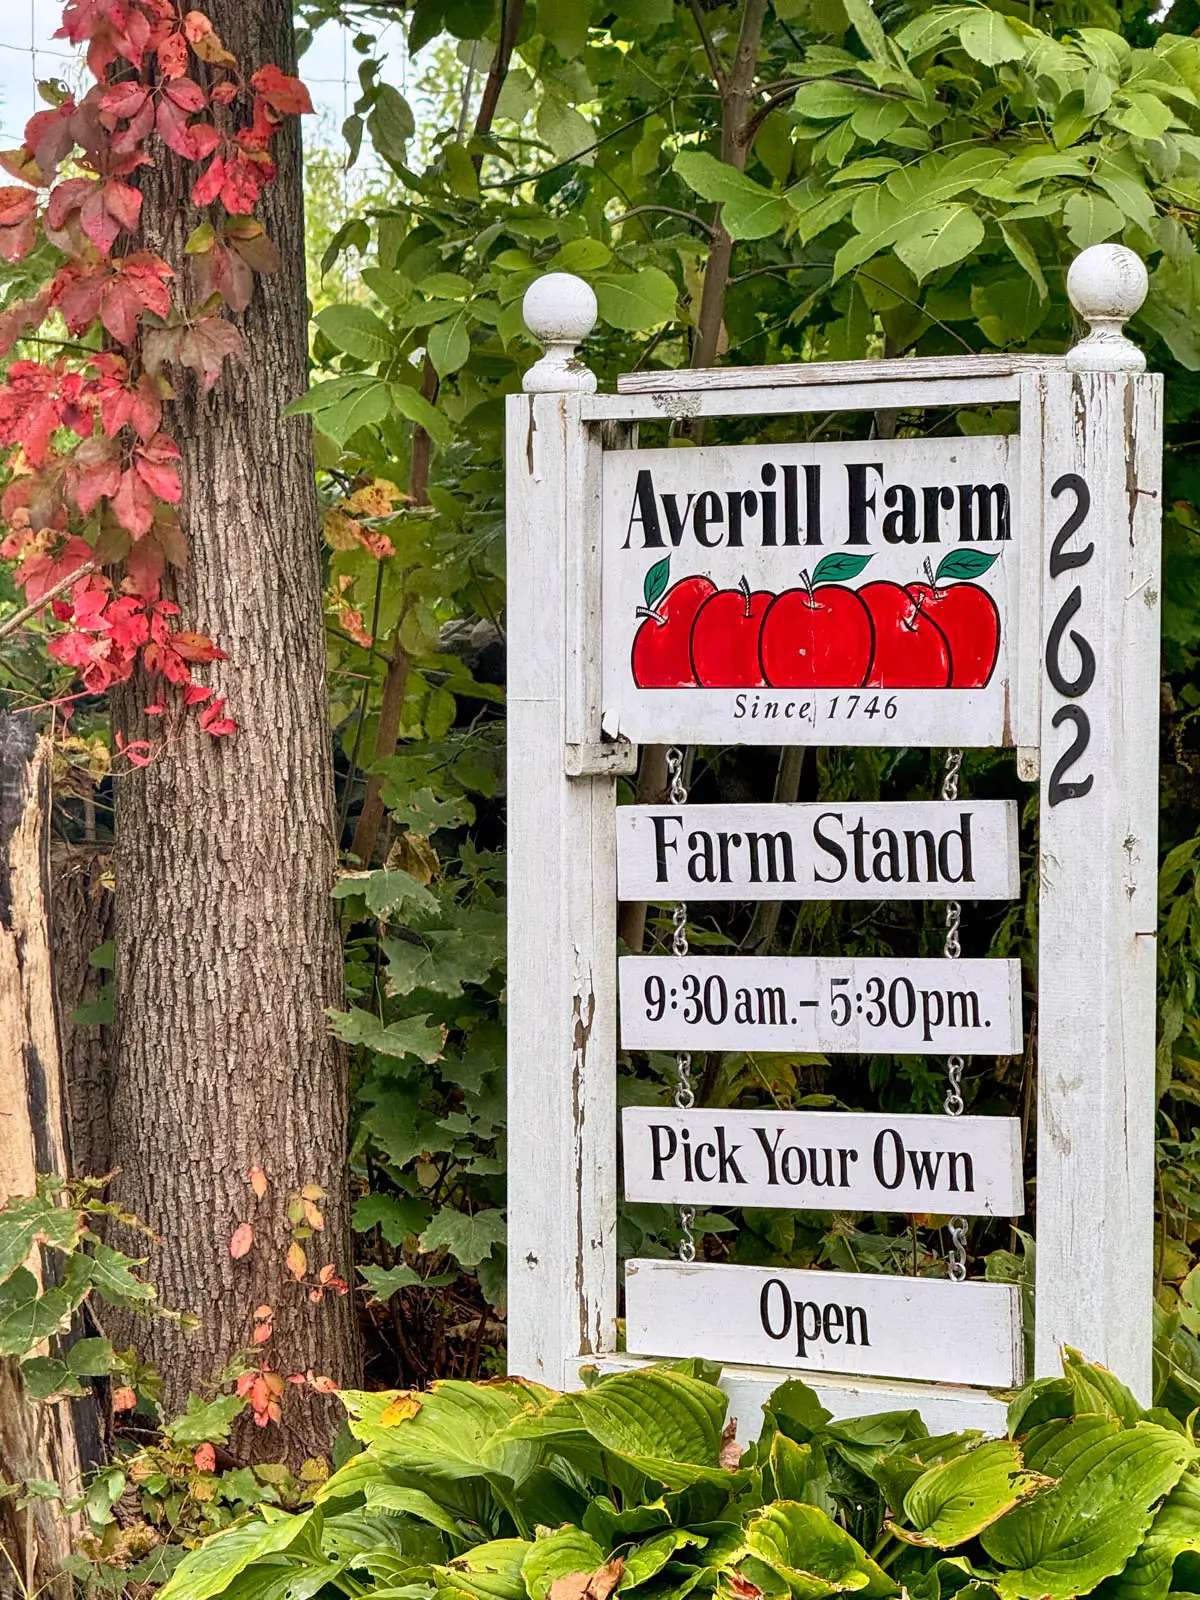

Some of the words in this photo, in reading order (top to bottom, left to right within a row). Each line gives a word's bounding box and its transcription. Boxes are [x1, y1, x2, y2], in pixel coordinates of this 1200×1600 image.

[620, 461, 824, 550] Averill
[842, 462, 1013, 546] Farm
[1045, 472, 1097, 808] 2622
[733, 693, 812, 720] Since
[827, 694, 899, 720] 1746
[648, 815, 797, 884] Farm
[812, 811, 977, 884] Stand
[648, 1124, 749, 1185] Pick
[750, 1127, 859, 1188] Your
[873, 1127, 976, 1193] Own
[759, 1278, 872, 1358] Open
